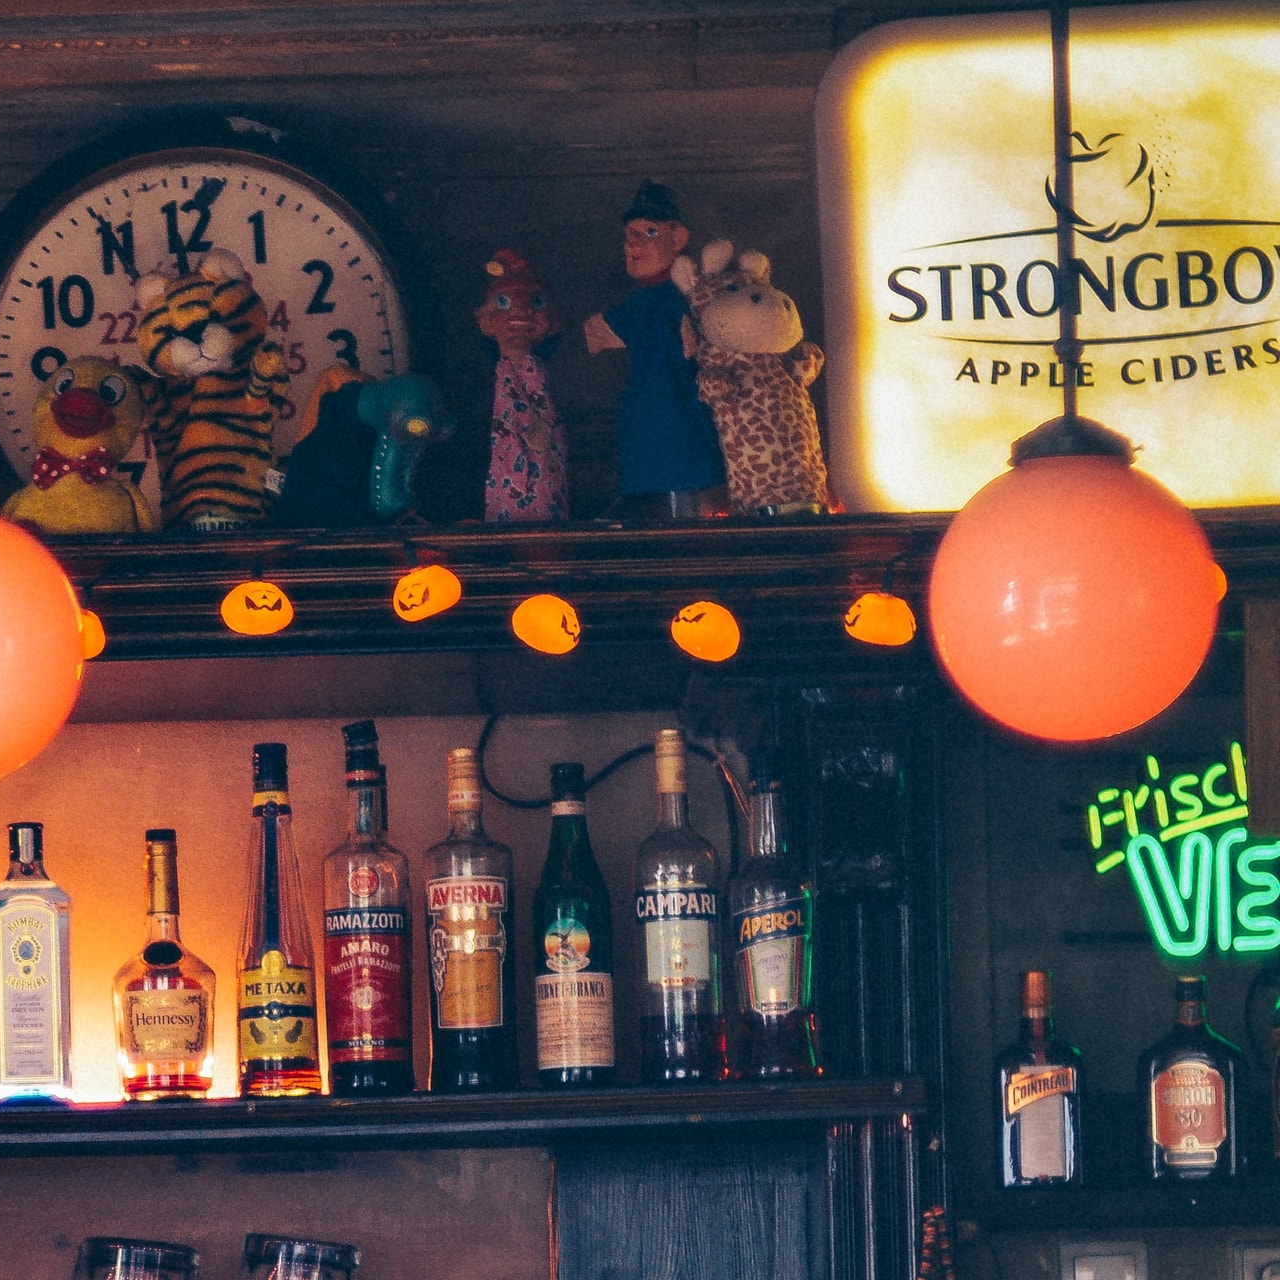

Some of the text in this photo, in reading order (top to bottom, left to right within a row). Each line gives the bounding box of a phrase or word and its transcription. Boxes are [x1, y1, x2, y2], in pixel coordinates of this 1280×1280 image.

[160, 200, 214, 253] 12
[247, 210, 267, 264] 1
[301, 260, 336, 314] 2
[886, 246, 1280, 323] STRONGBO
[37, 274, 95, 329] 10
[99, 312, 138, 345] 22
[956, 338, 1280, 388] APPLE CIDERS
[431, 885, 503, 907] AVERNA
[636, 892, 716, 918] CAMPARI
[7, 917, 46, 933] BOMBAY
[326, 913, 404, 932] RAMAZZOTTI
[739, 910, 804, 943] APEROL
[341, 941, 390, 958] AMARO
[8, 974, 48, 992] SAPPHIRE
[135, 1012, 197, 1027] Hennessy
[348, 1039, 385, 1047] MILANO
[1013, 1074, 1070, 1106] COINTREAU
[1164, 1087, 1216, 1106] STROH
